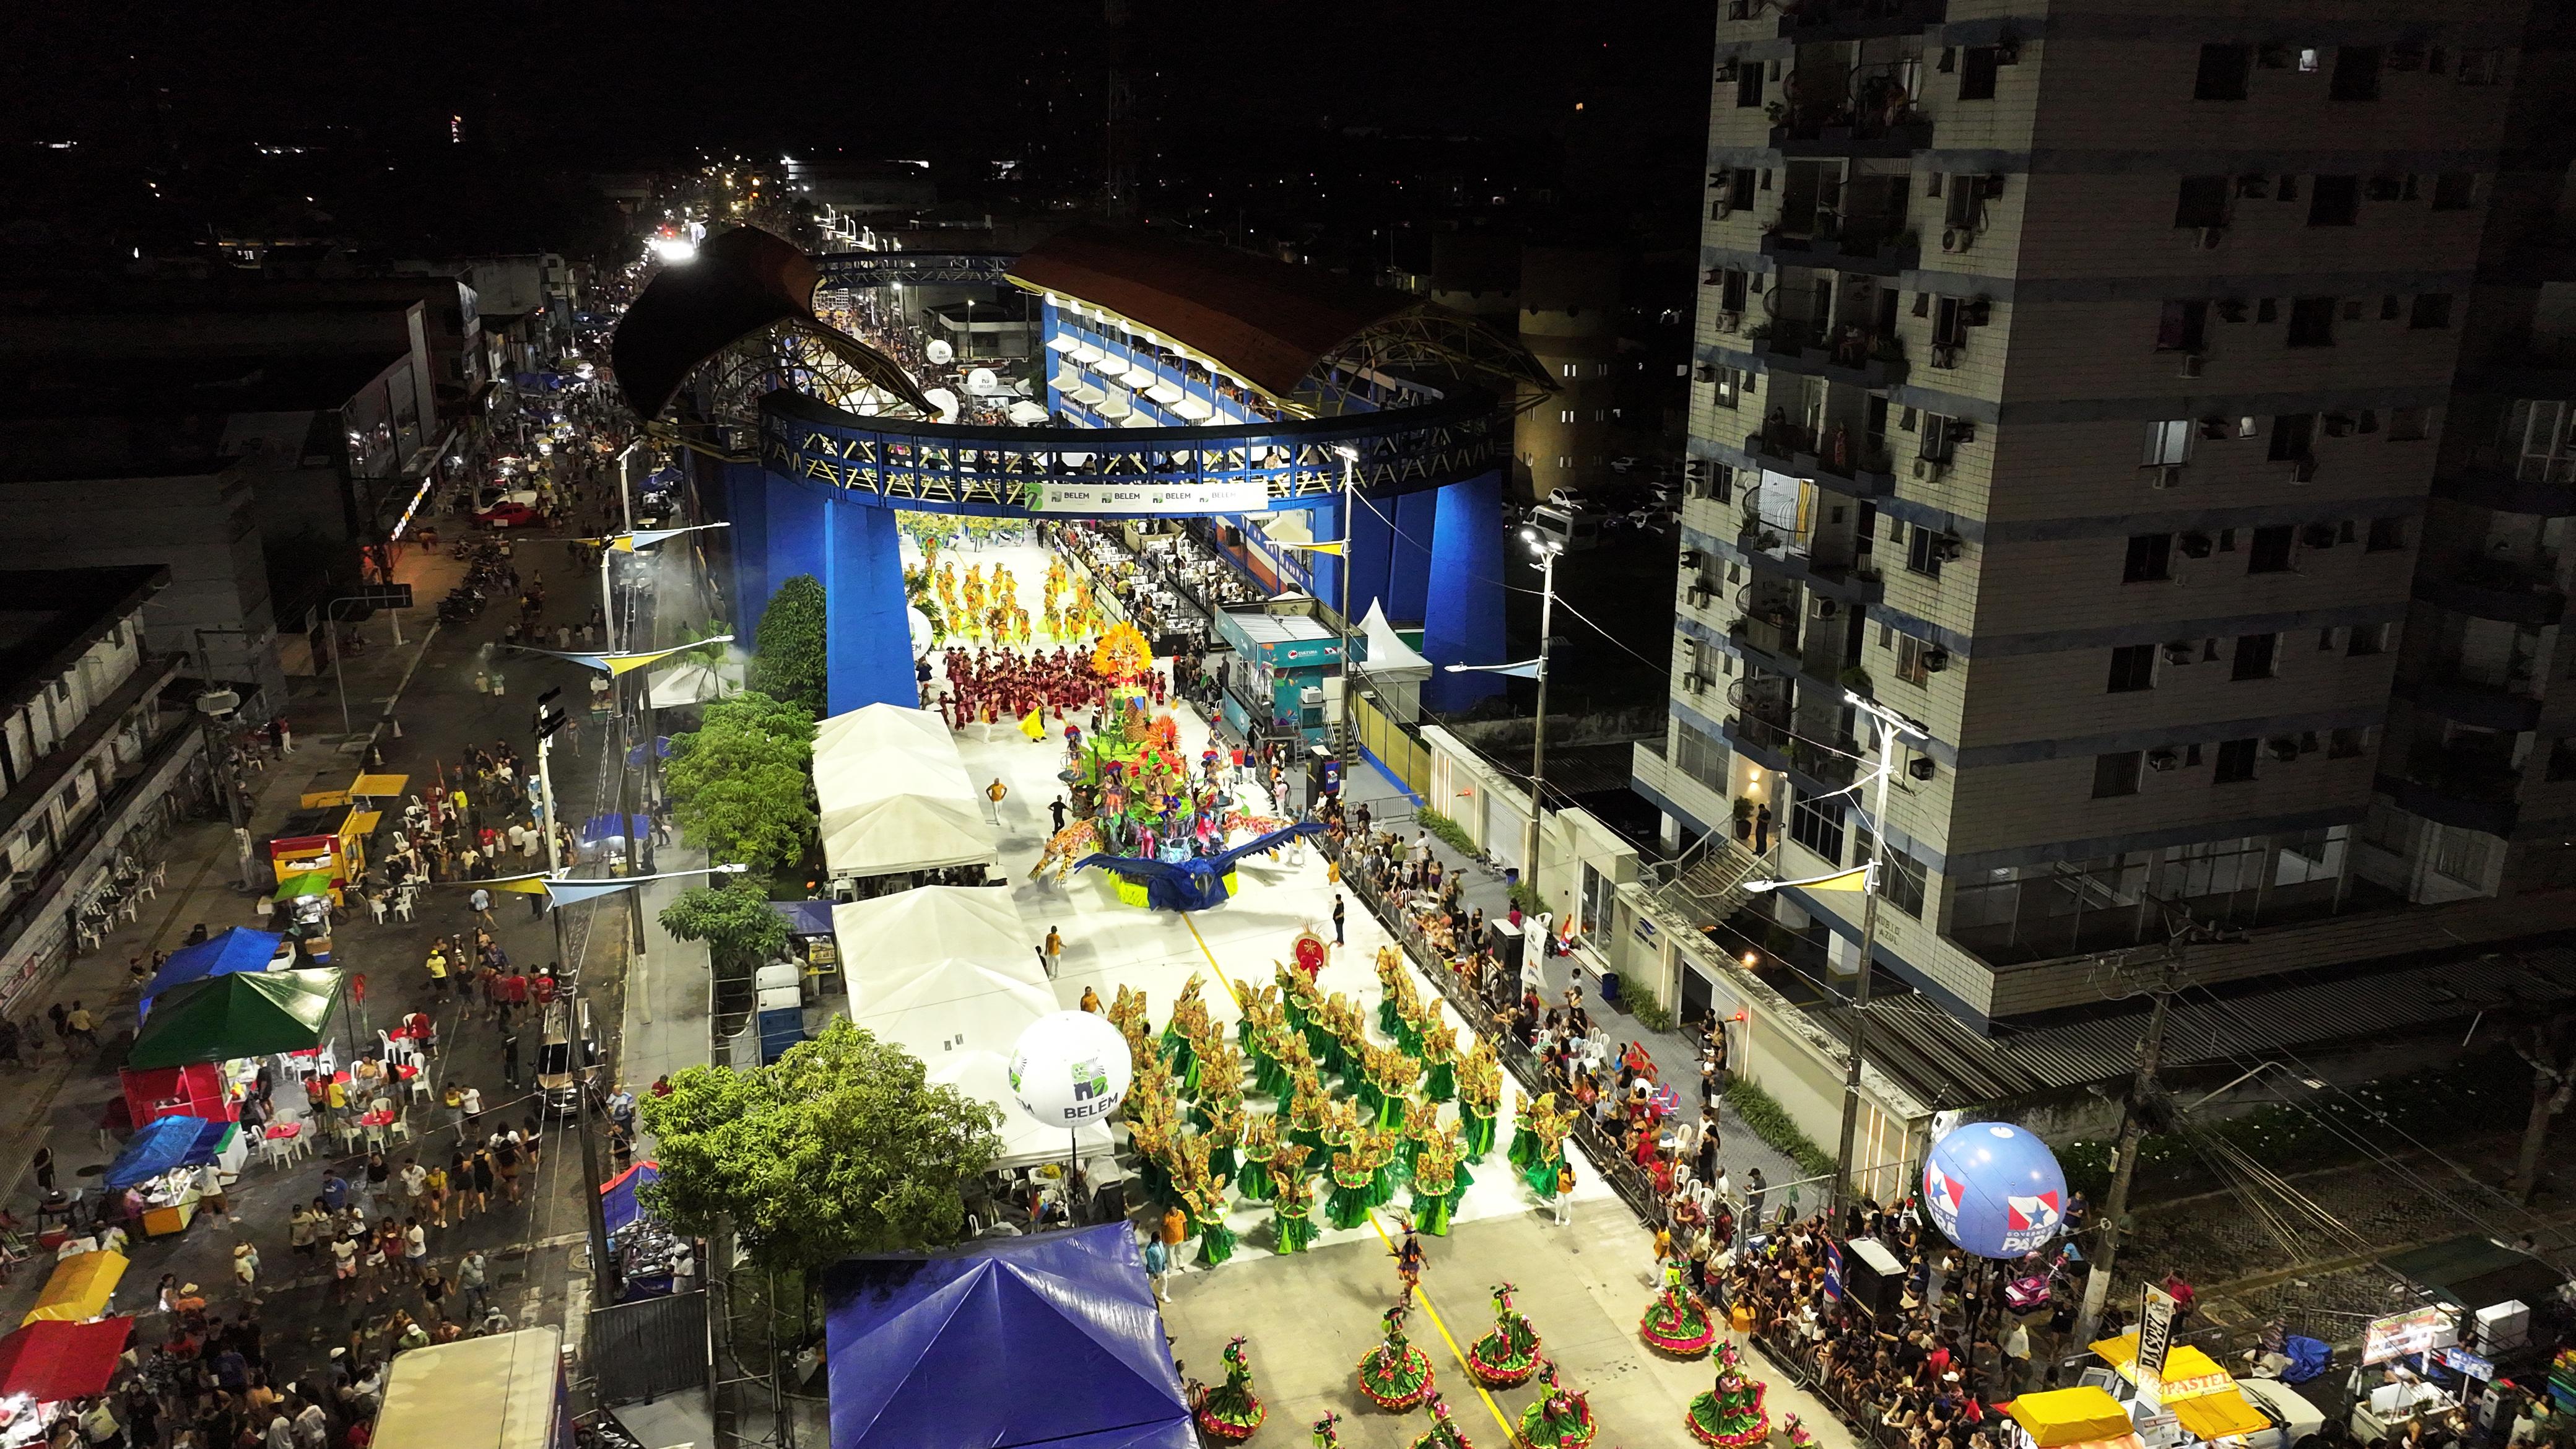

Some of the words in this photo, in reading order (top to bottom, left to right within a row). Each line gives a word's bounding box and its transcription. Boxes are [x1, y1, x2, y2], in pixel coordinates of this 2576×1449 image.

[1879, 929, 1899, 946] AZUL
[1064, 1092, 1118, 1119] BELÉM
[1945, 1214, 1956, 1223] DO
[2006, 1229, 2046, 1237] GOVERNO
[2165, 1372, 2232, 1395] PASTEL
